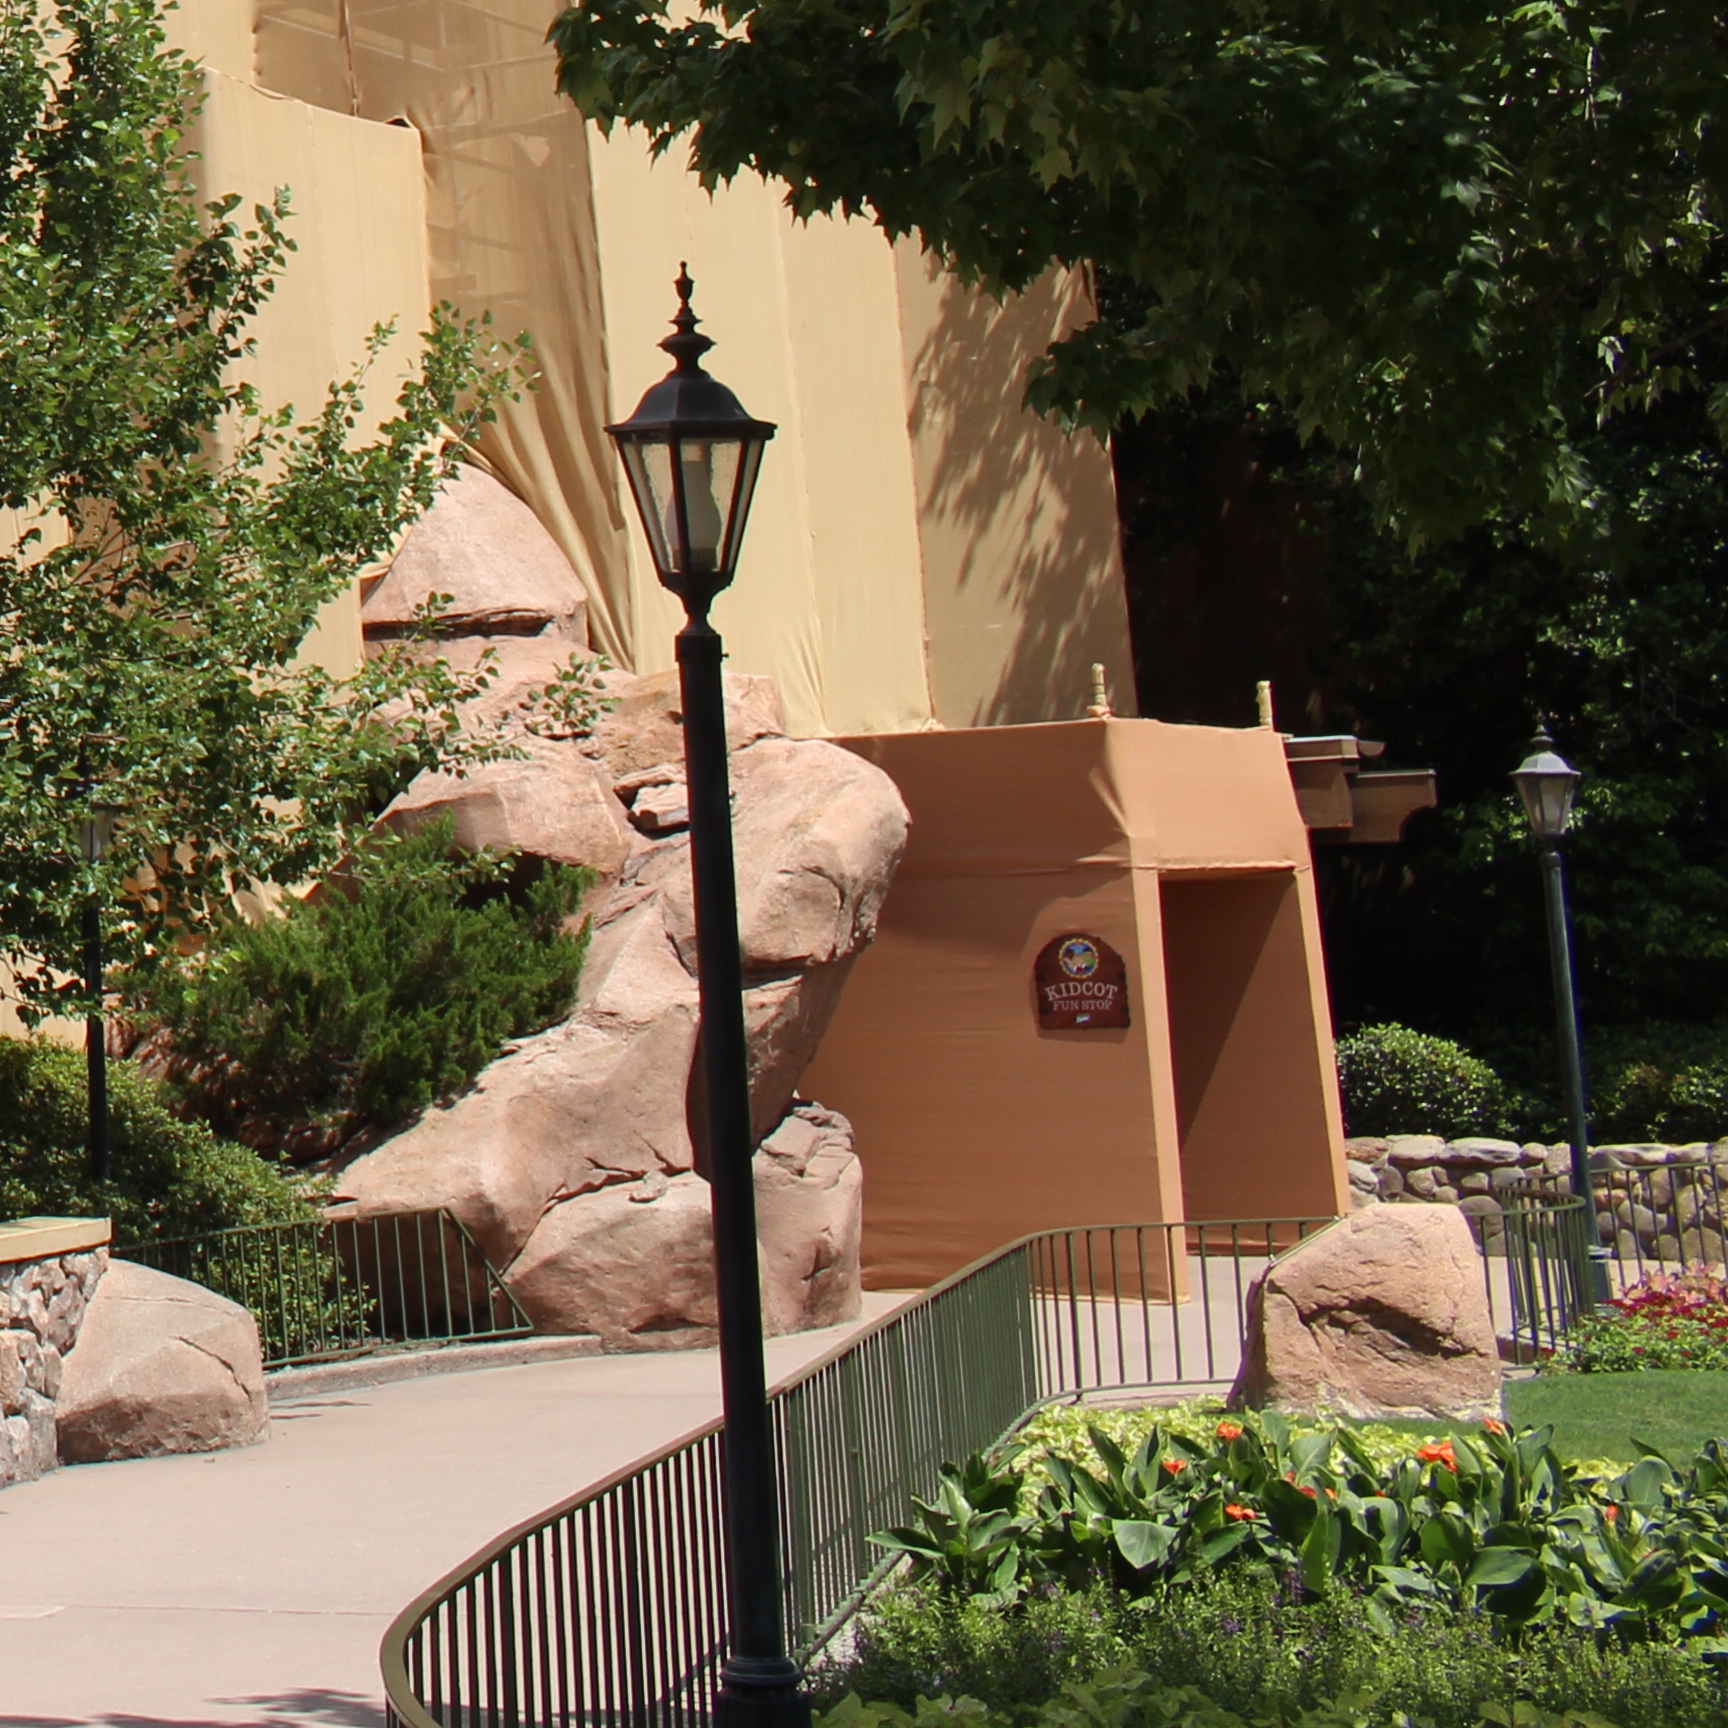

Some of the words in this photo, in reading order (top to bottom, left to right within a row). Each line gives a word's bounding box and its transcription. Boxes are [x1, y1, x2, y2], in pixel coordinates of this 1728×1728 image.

[1044, 981, 1118, 1001] KIDCOT
[1052, 1000, 1079, 1011] FUN
[1081, 999, 1112, 1010] STOP
